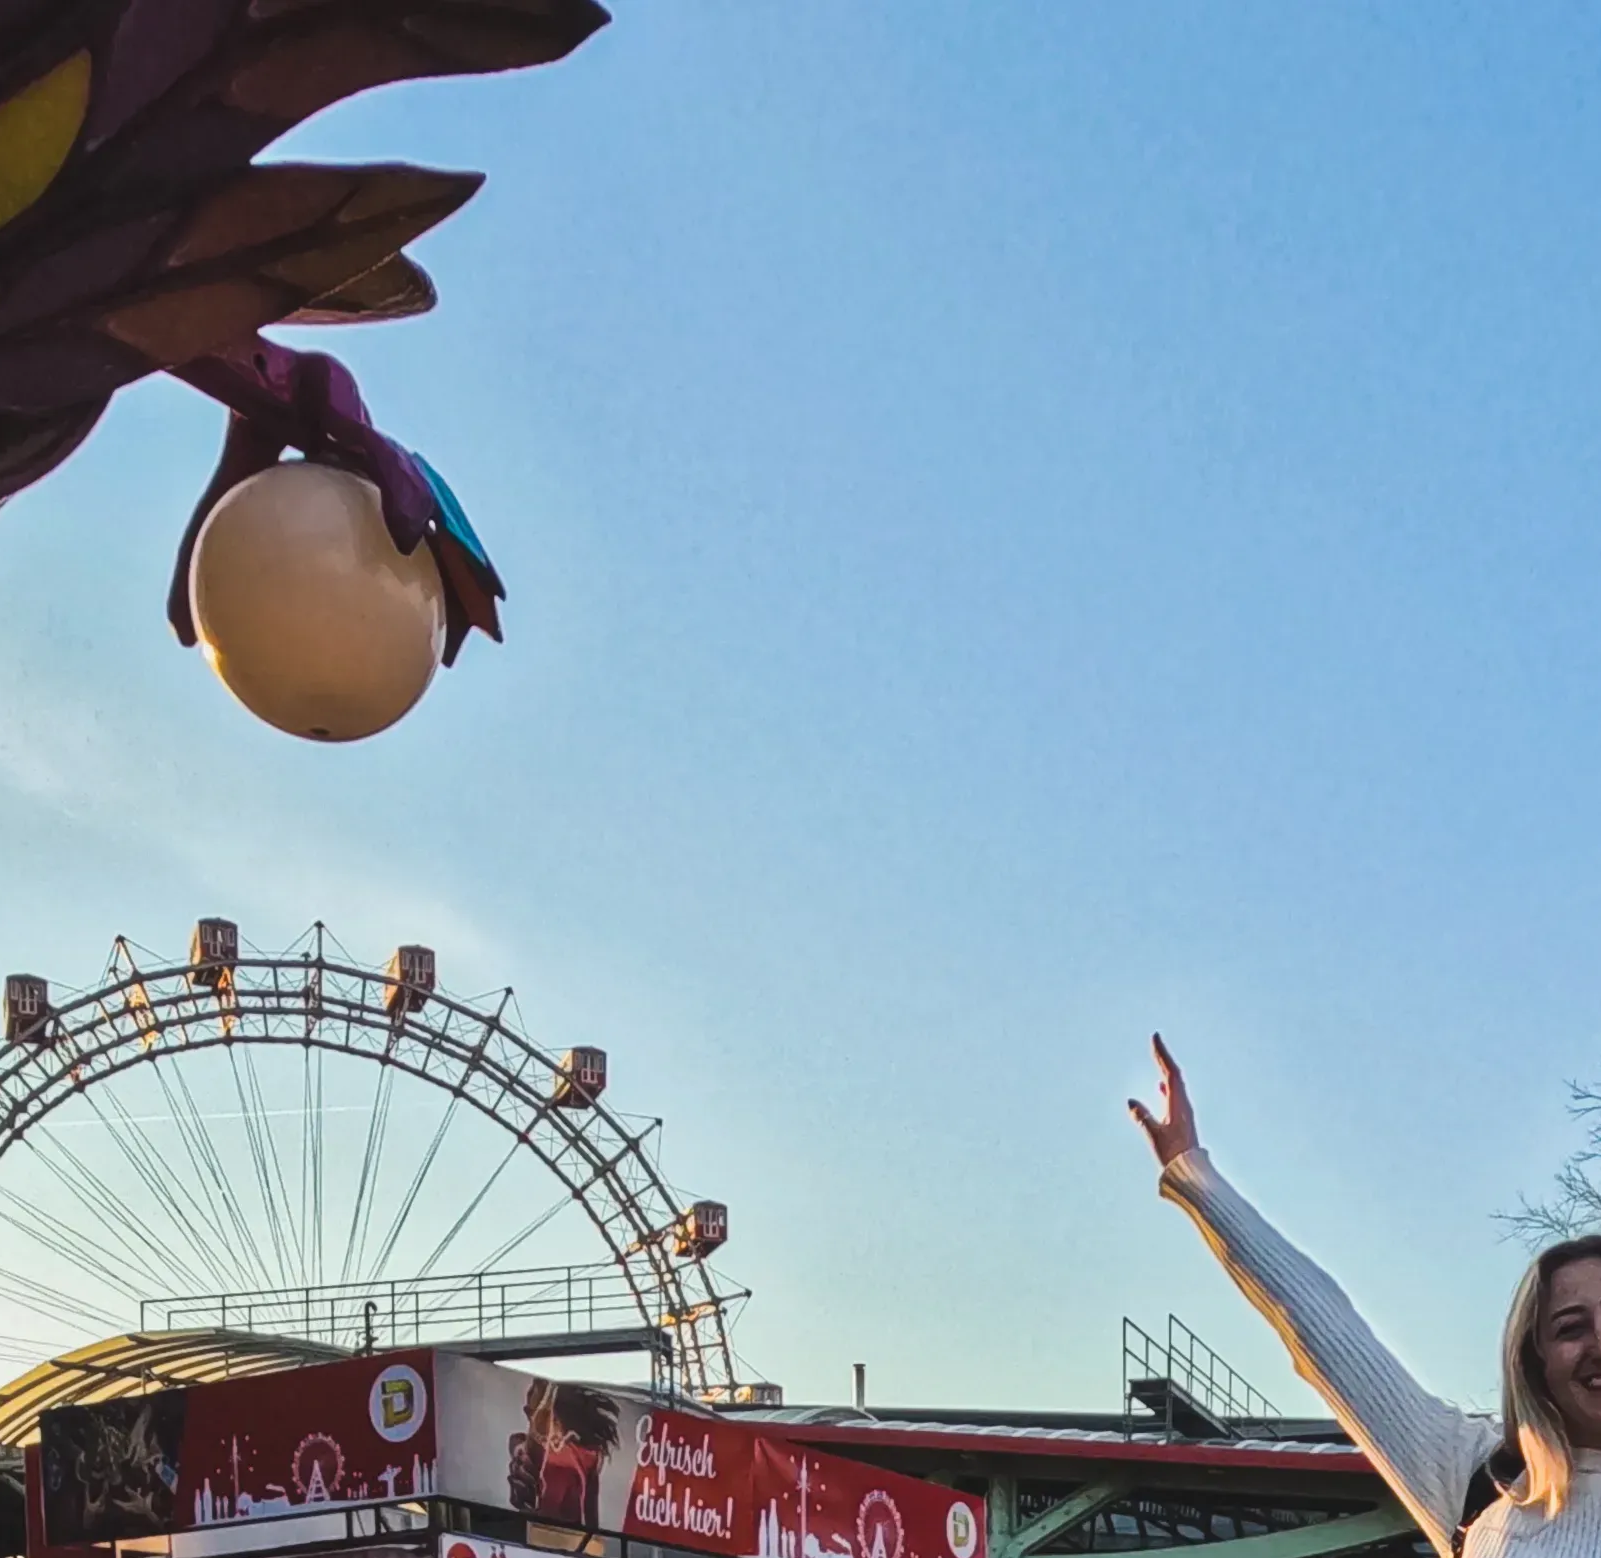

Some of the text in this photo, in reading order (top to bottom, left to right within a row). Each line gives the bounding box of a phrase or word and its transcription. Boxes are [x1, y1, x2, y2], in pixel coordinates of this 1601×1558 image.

[636, 1415, 716, 1485] Erfrisch
[635, 1477, 733, 1540] dich hier!
